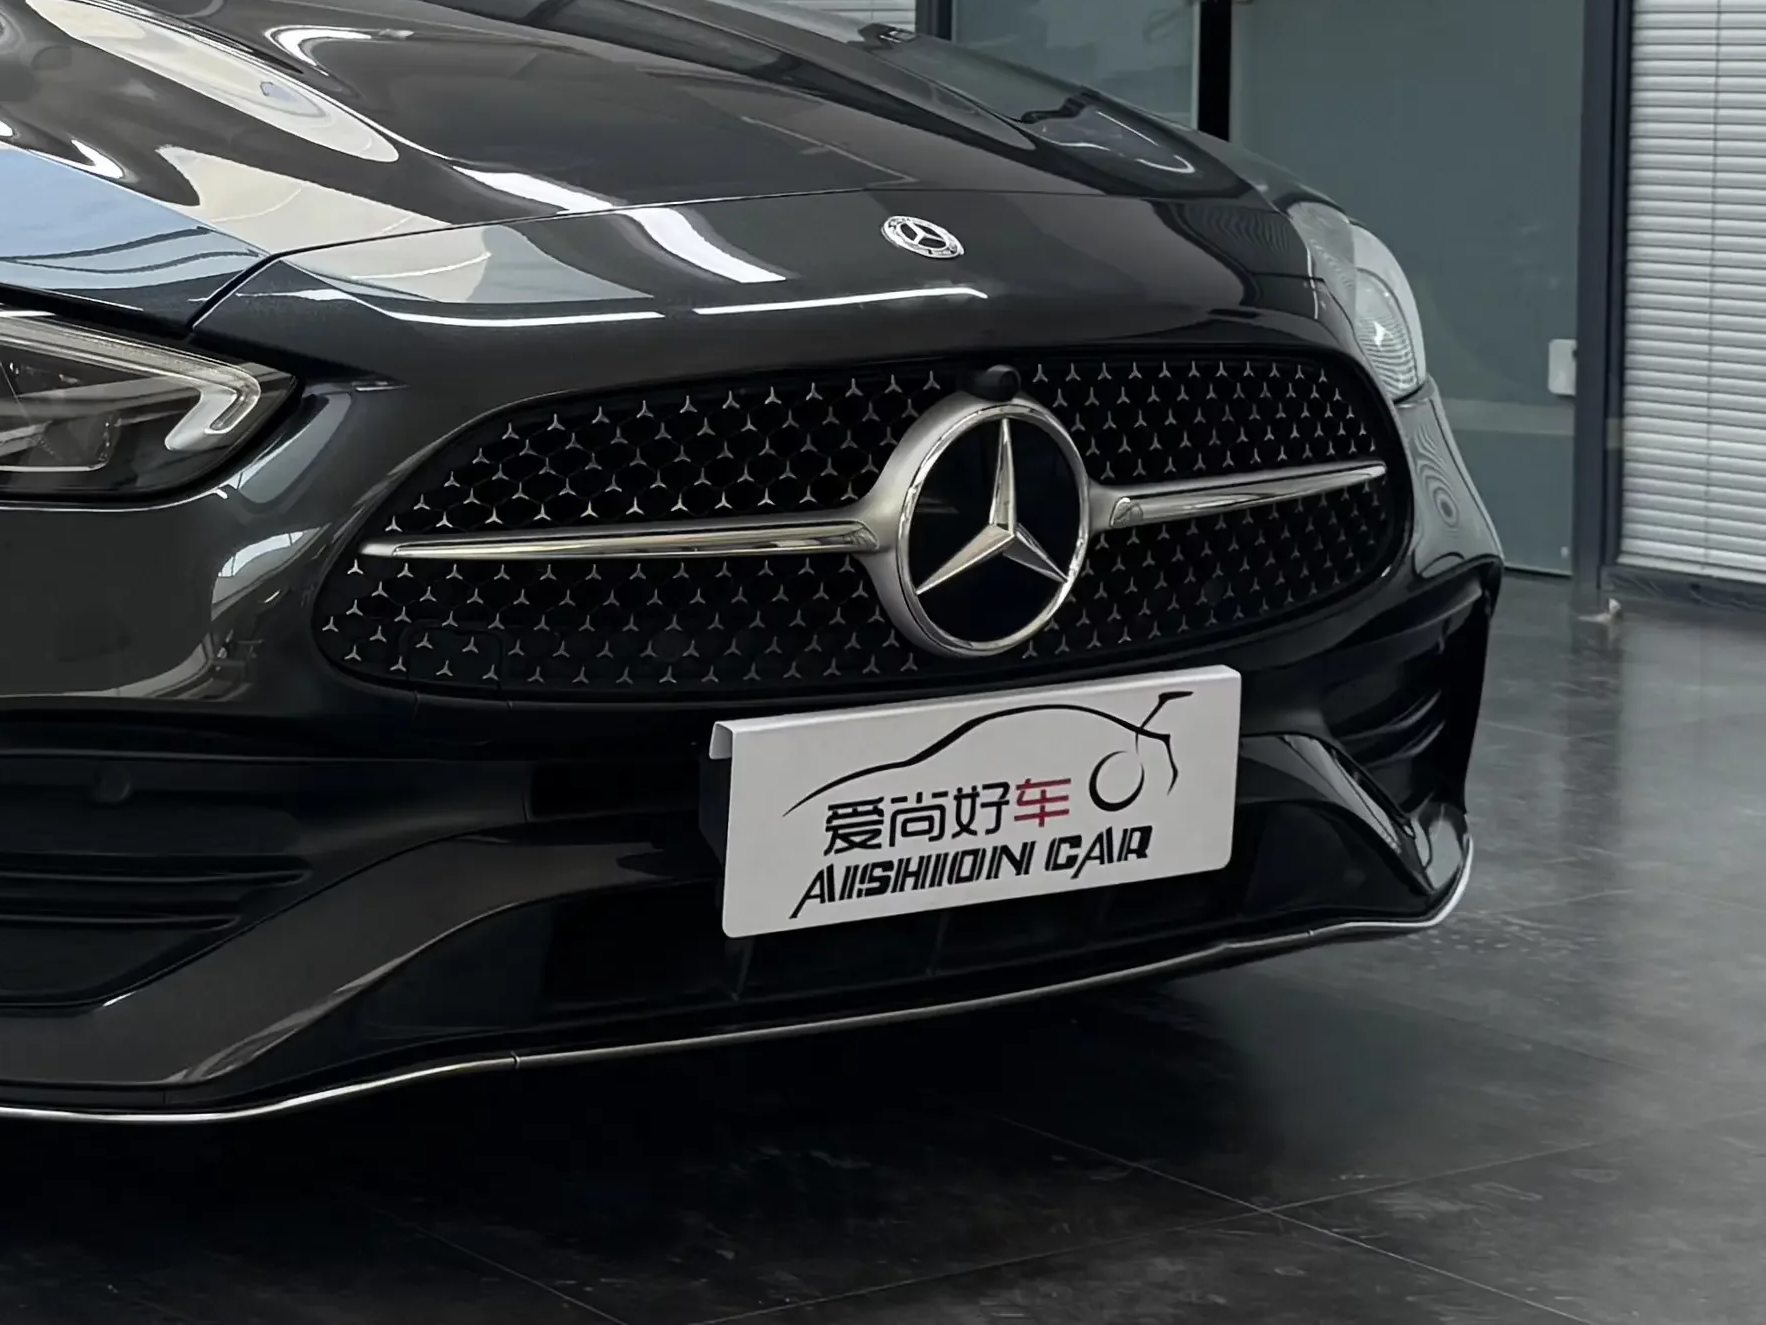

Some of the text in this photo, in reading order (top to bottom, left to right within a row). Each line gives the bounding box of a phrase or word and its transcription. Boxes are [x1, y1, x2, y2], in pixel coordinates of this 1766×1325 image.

[823, 777, 1072, 856] 爱尚好车
[789, 824, 1154, 920] AISHION CAR
